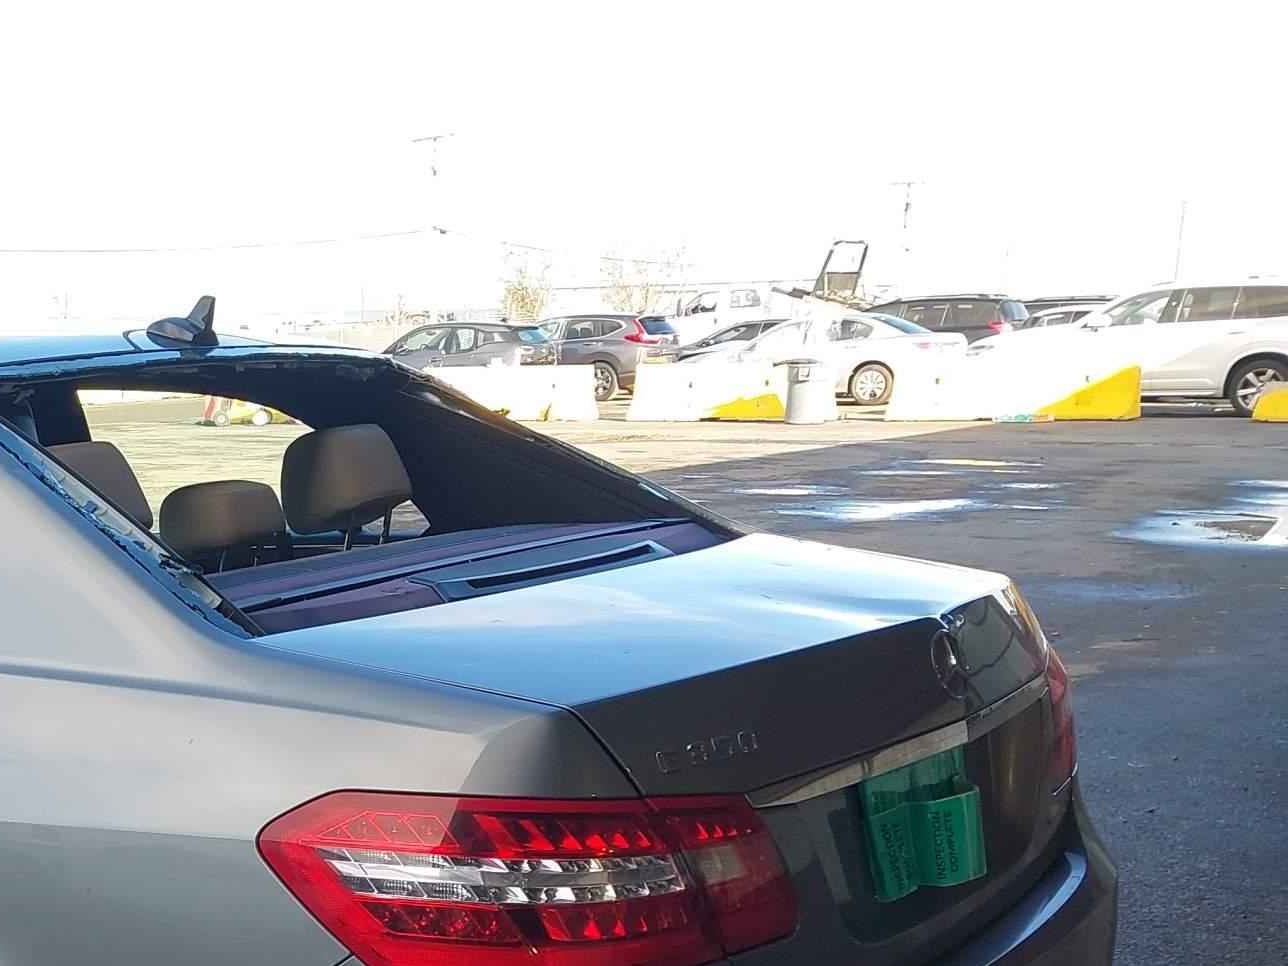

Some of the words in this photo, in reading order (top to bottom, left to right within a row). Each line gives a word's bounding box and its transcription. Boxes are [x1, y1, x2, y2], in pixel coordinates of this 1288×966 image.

[879, 822, 905, 891] INSPECTION
[930, 811, 947, 880] INSPECTION
[944, 811, 959, 873] COMPLETE
